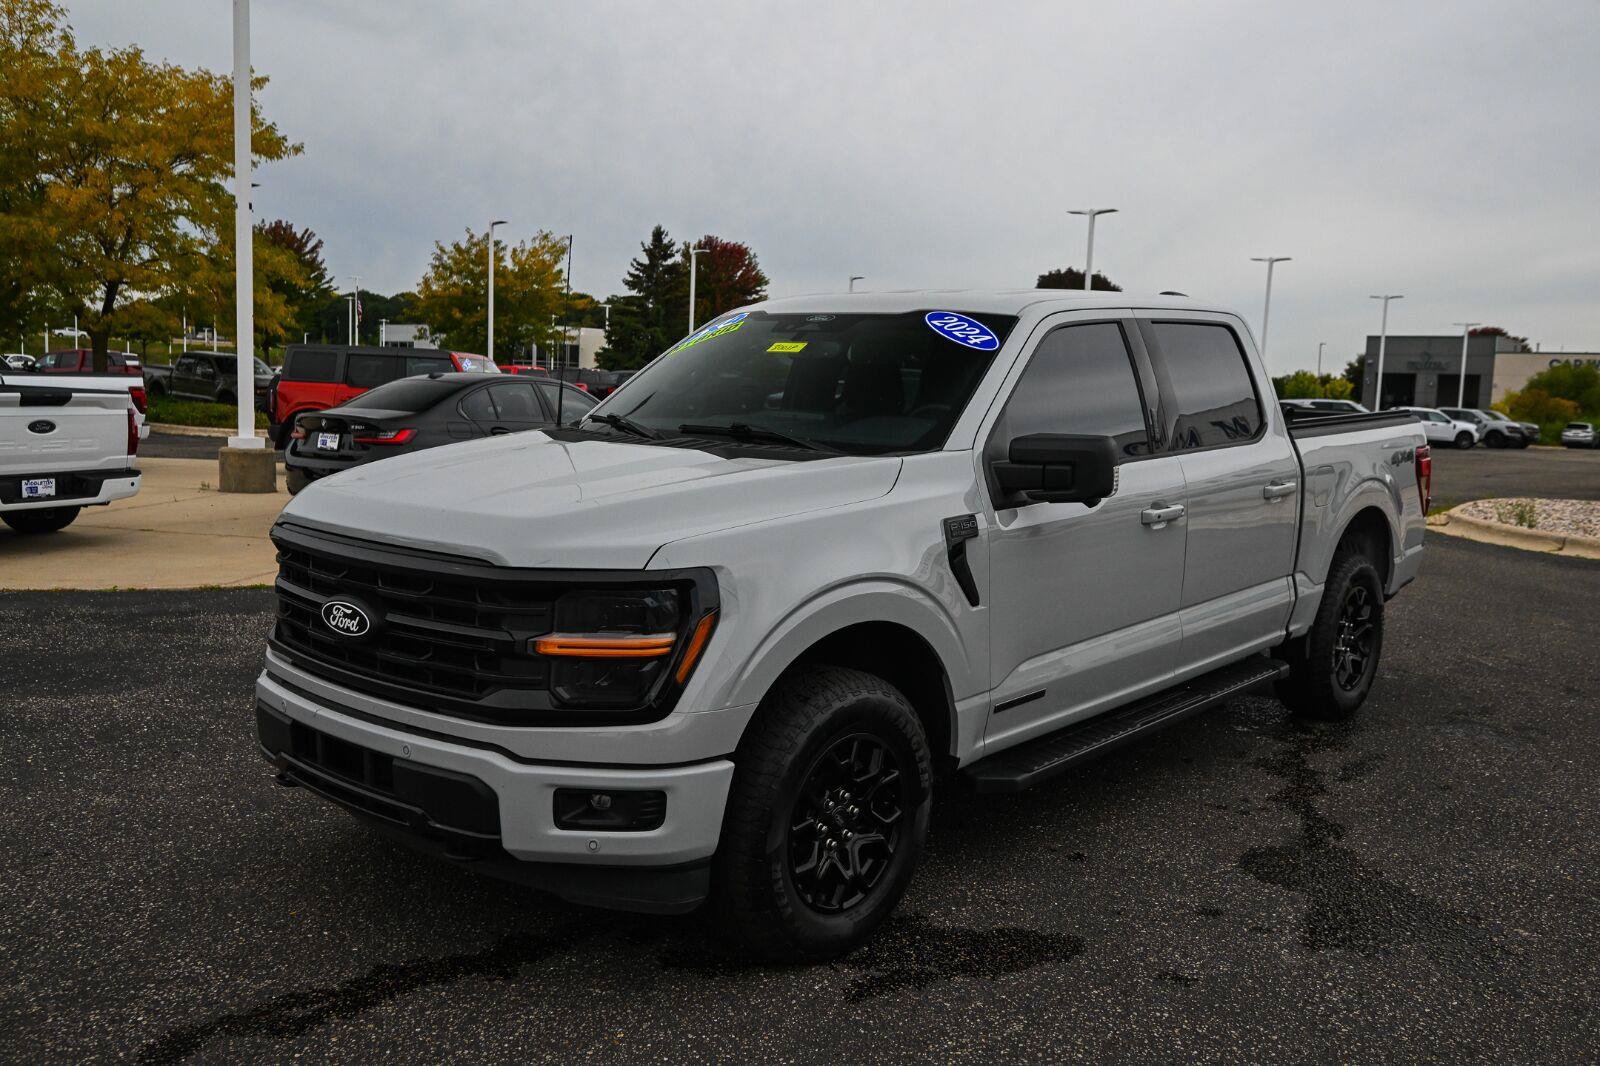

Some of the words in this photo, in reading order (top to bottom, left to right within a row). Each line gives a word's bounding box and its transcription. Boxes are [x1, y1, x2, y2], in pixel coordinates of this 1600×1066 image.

[930, 316, 993, 344] 2024
[950, 520, 977, 531] F-150
[330, 604, 360, 632] Ford
